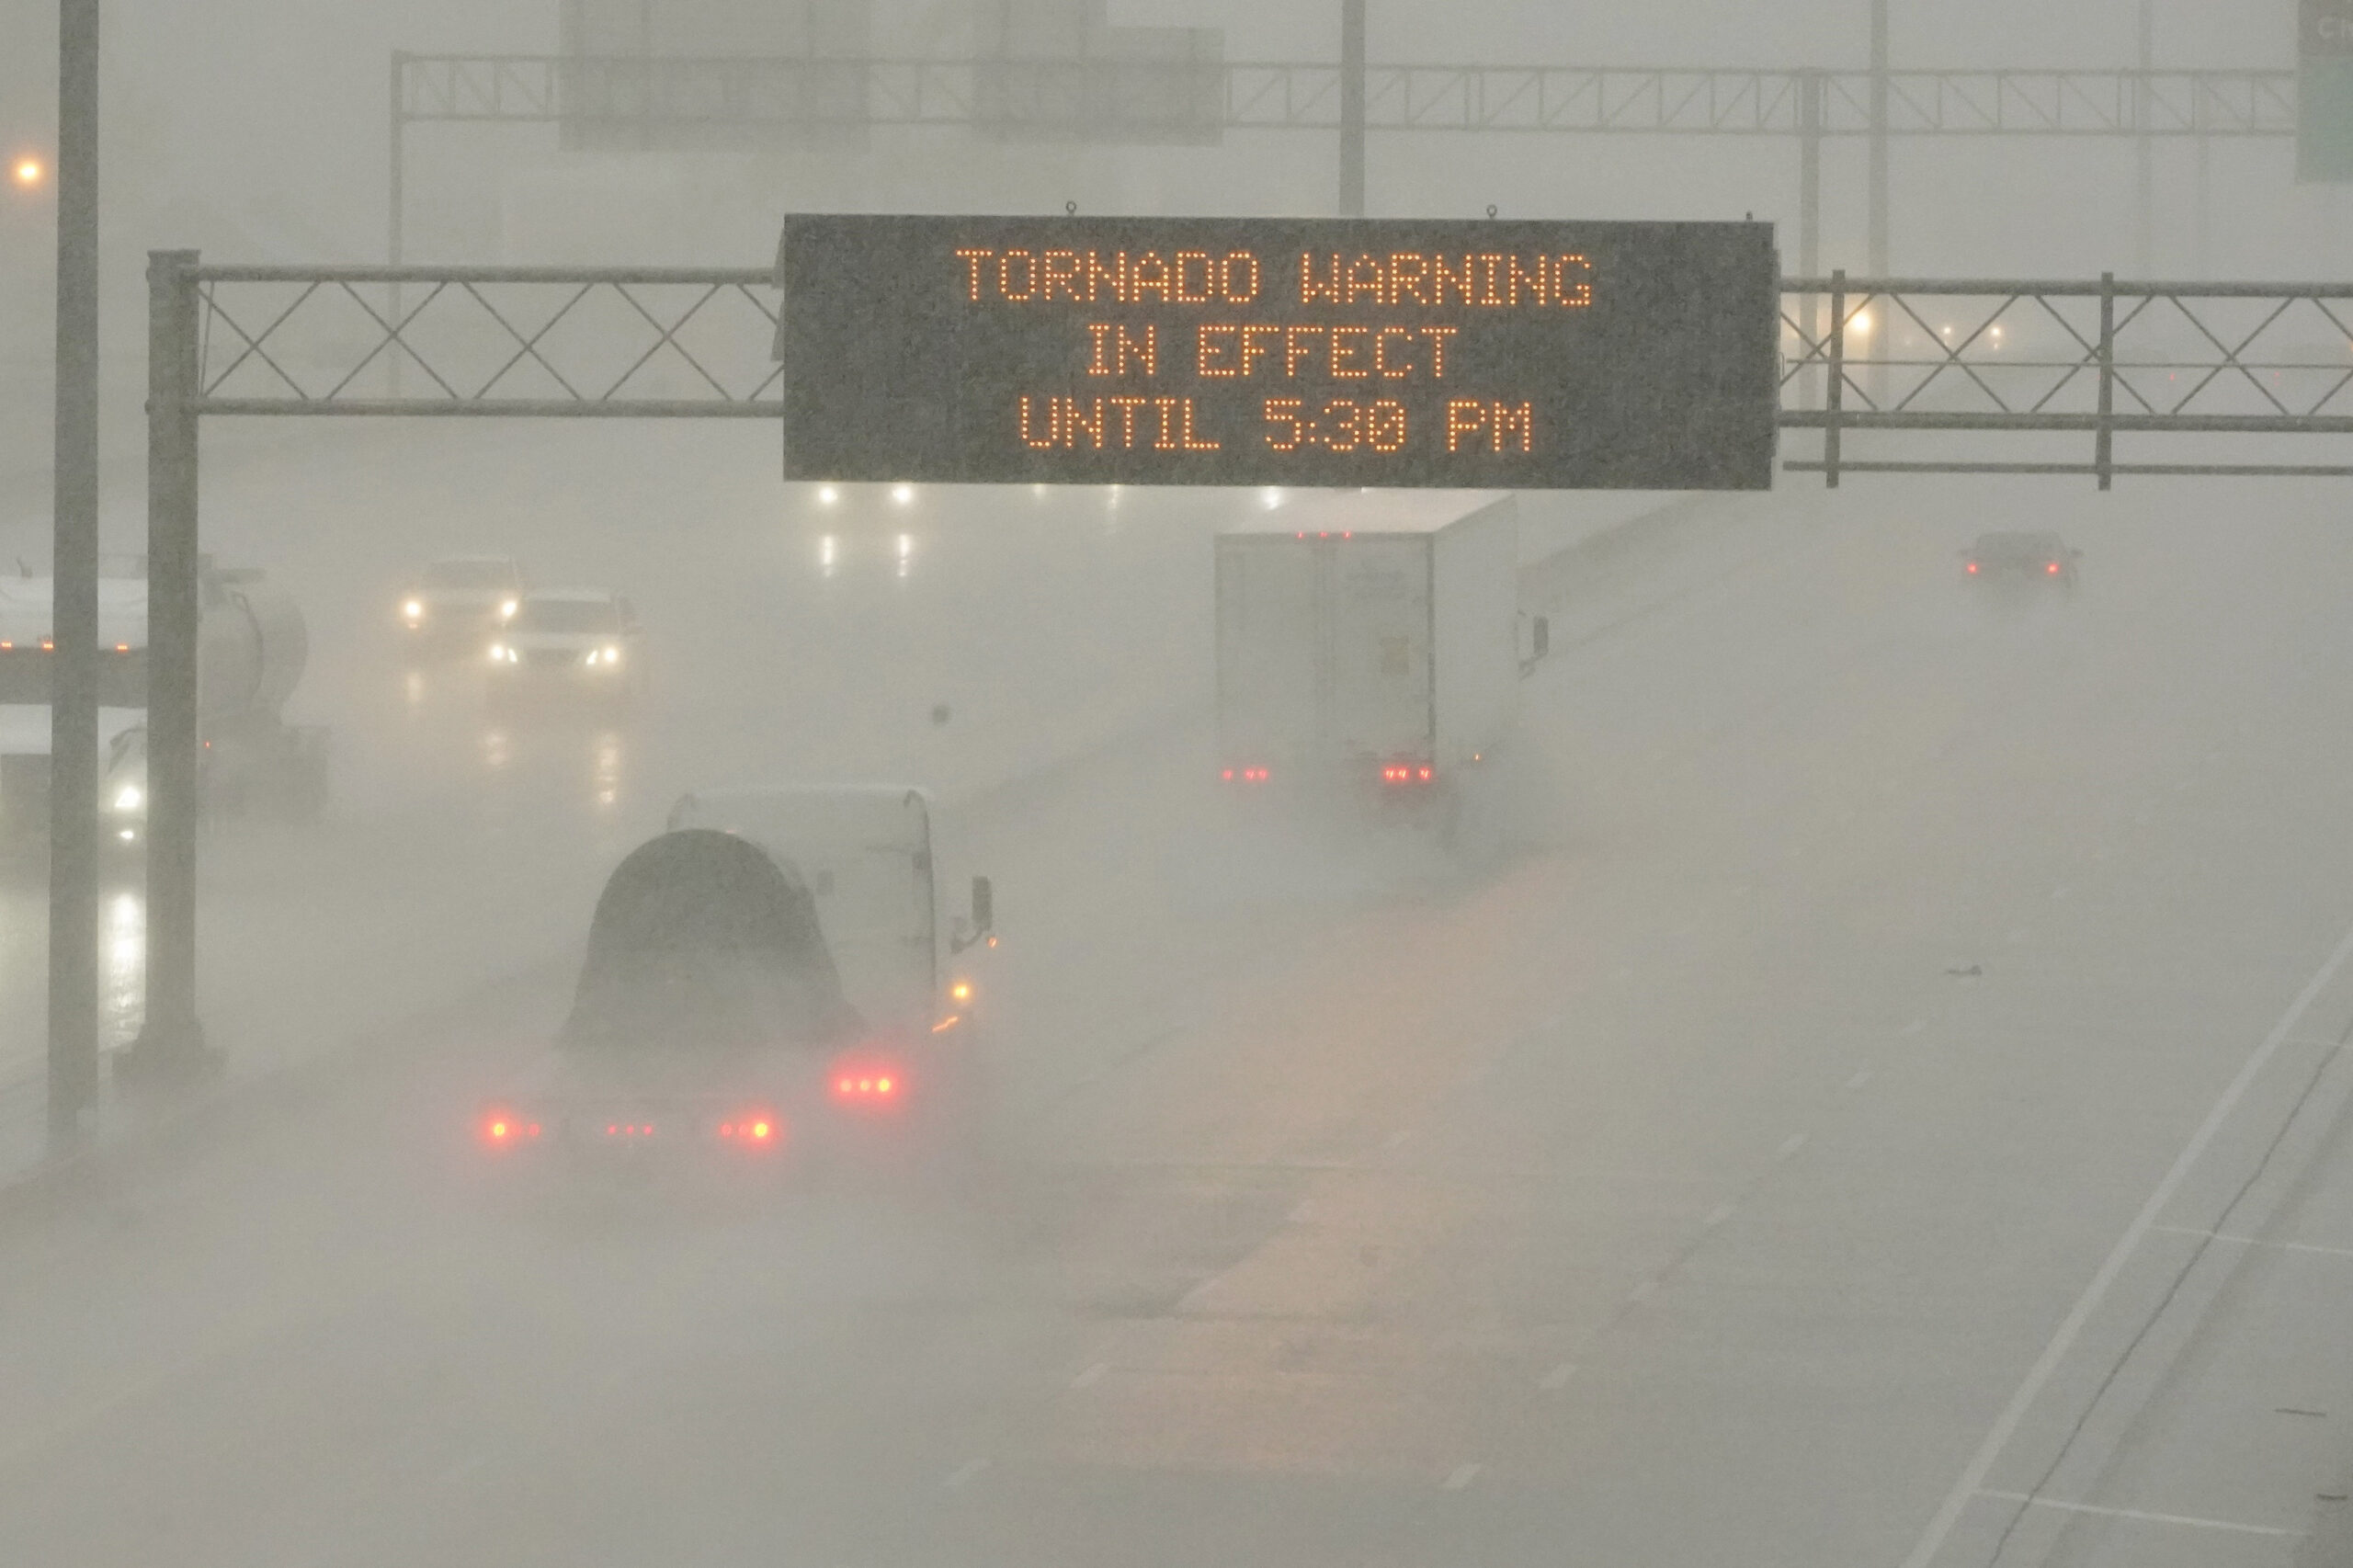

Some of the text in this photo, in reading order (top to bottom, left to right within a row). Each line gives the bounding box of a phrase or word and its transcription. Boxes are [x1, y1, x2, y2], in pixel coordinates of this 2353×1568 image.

[955, 249, 1591, 306] TORNADO WARNING
[1087, 323, 1457, 378] IN EFFECT
[1019, 396, 1531, 452] UNTIL 5:30 PM
